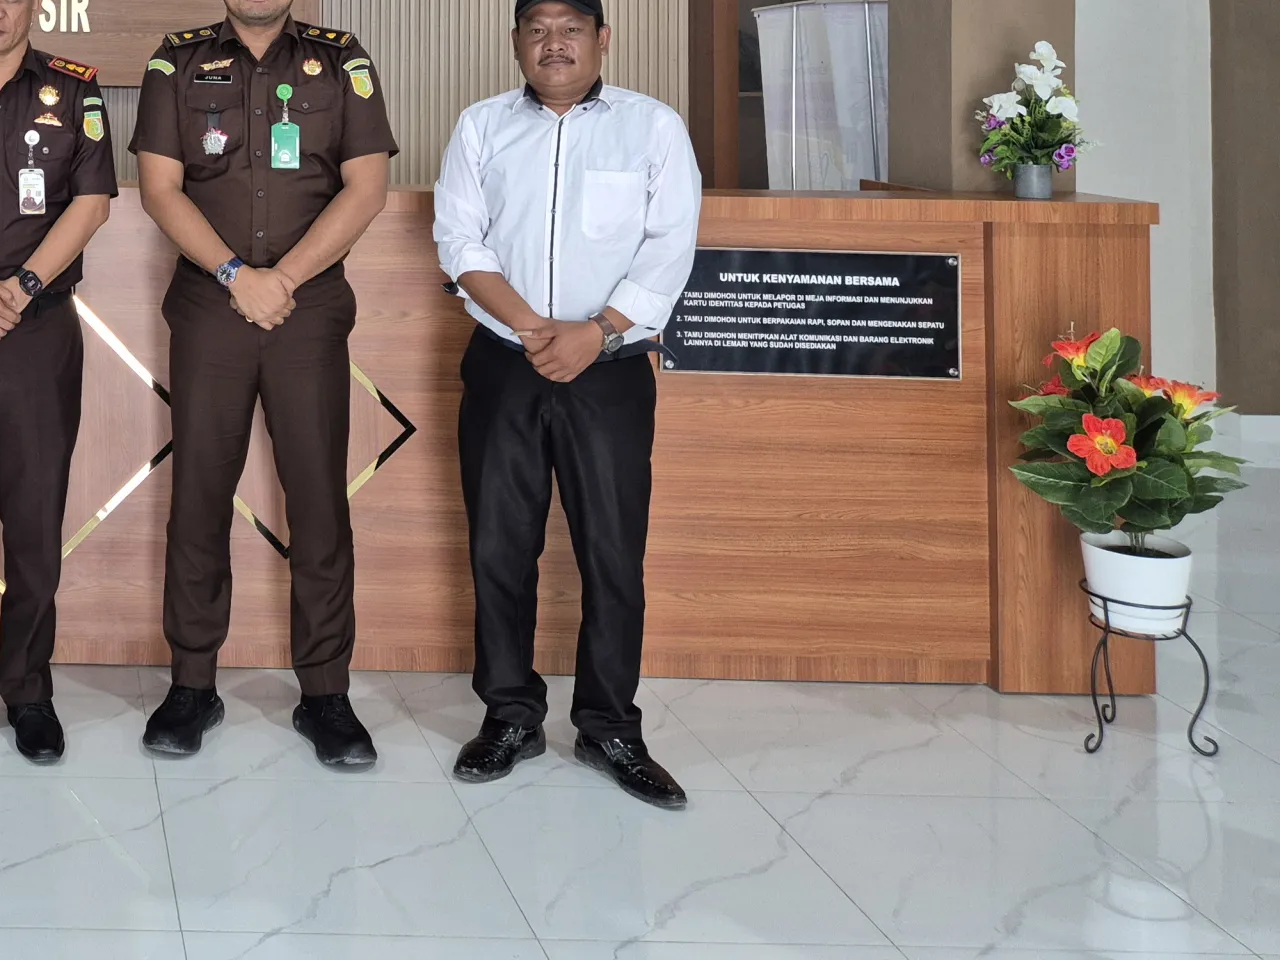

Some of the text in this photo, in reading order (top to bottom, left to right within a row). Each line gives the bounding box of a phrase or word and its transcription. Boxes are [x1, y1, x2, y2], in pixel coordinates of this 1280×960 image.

[719, 272, 900, 287] UNTUK KENYAMANAN BERSAMA
[880, 297, 933, 305] MENUNJUKKAN
[762, 317, 806, 325] BERPAKAIAN
[807, 319, 825, 327] RAPI,
[738, 332, 779, 340] MENITIPKAN
[799, 334, 842, 342] KOMUNIKASI
[769, 341, 793, 349] SUDAH
